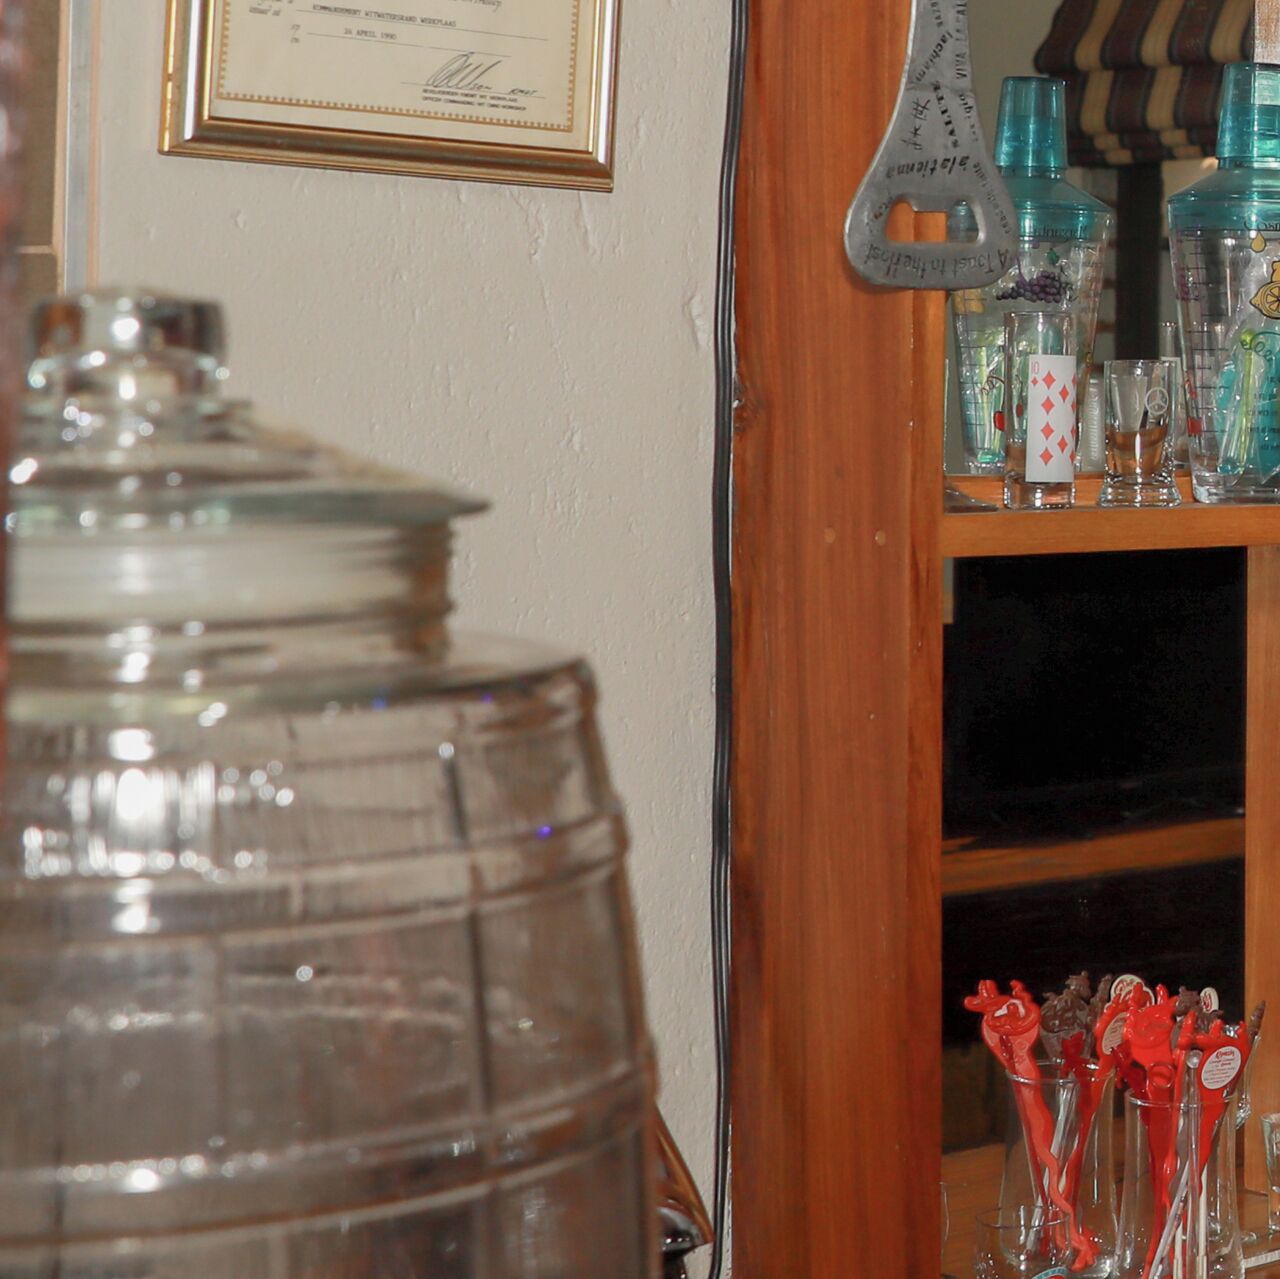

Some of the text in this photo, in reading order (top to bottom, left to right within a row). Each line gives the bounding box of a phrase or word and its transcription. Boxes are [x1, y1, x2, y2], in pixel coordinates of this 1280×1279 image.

[930, 256, 945, 274] to
[997, 248, 1009, 267] A
[903, 256, 925, 279] the
[1031, 361, 1041, 374] 10
